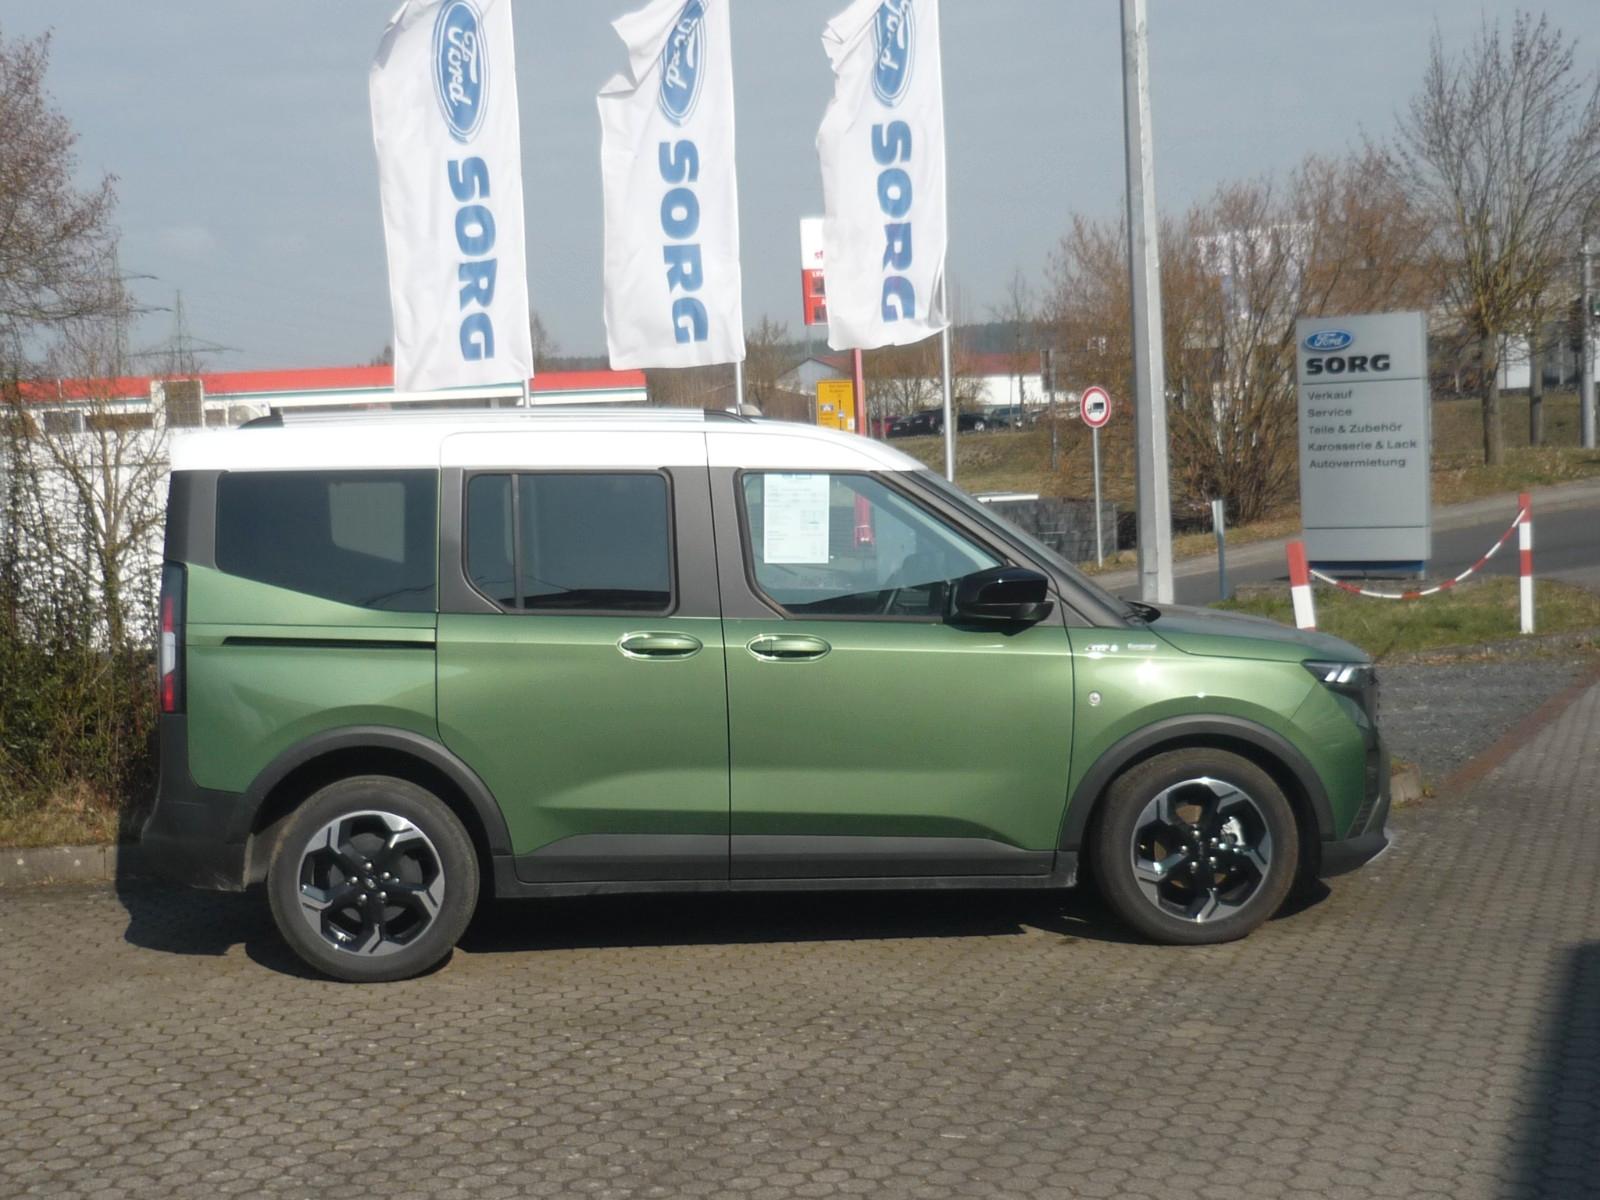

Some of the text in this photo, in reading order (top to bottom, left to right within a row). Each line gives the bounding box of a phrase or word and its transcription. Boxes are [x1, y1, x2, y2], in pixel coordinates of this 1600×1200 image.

[665, 18, 698, 90] Ford
[447, 26, 479, 108] Ford
[870, 119, 915, 323] SORG
[658, 139, 709, 345] SORG
[447, 156, 497, 362] SORG
[1314, 332, 1344, 347] Ford
[1306, 354, 1391, 376] SORG
[1307, 390, 1353, 400] Verkauf
[1307, 407, 1352, 418] Service
[1308, 422, 1402, 435] Teile & Zubehör
[1308, 439, 1417, 451] Karosserie & Lack
[1309, 458, 1406, 469] Autovermietung
